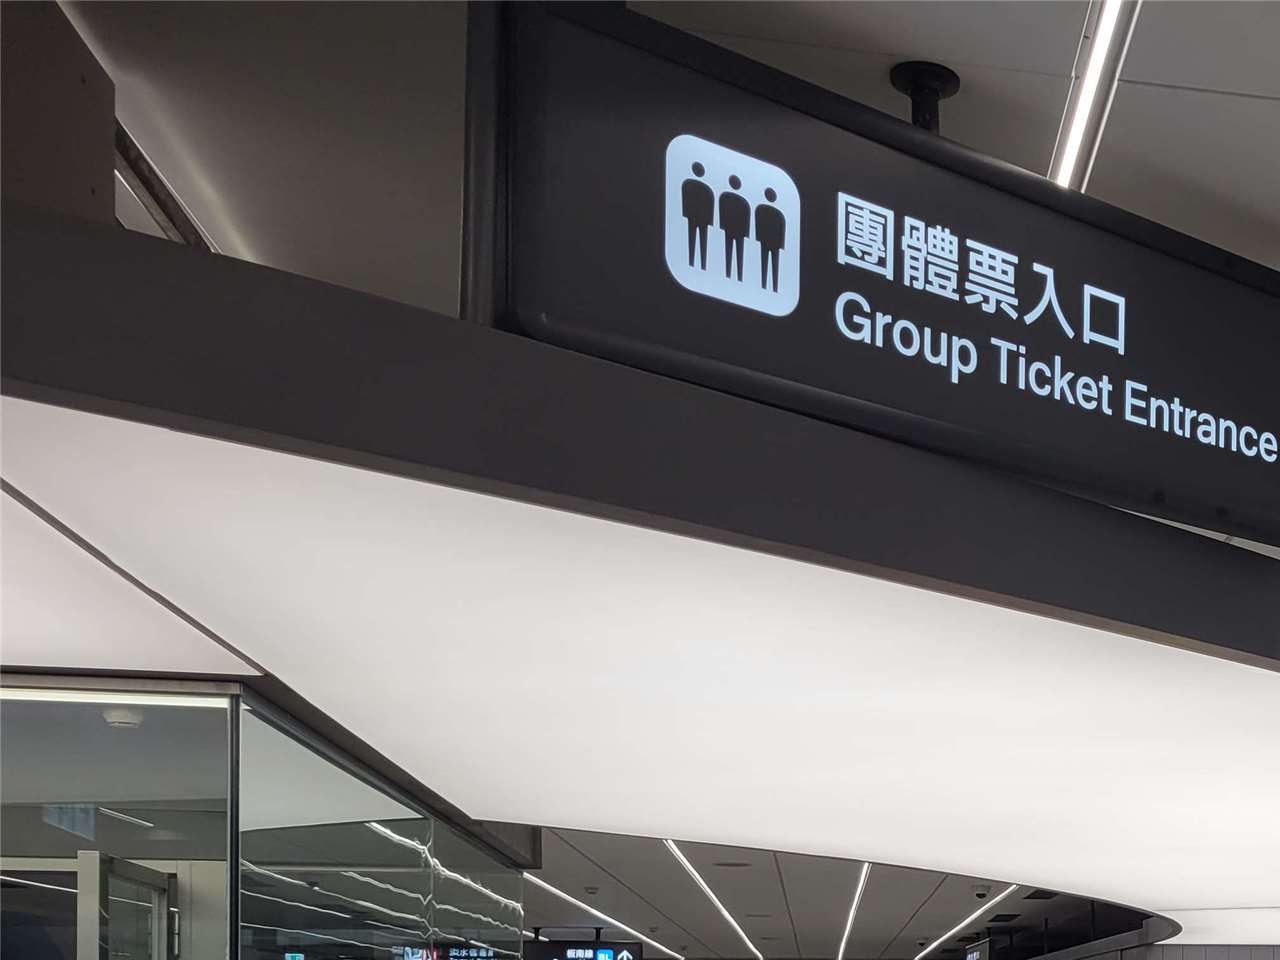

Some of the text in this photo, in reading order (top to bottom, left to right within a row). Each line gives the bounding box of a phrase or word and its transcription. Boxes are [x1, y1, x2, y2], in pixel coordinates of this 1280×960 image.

[836, 191, 1127, 356] 團體票入口
[835, 291, 1278, 463] Group Ticket Entrance
